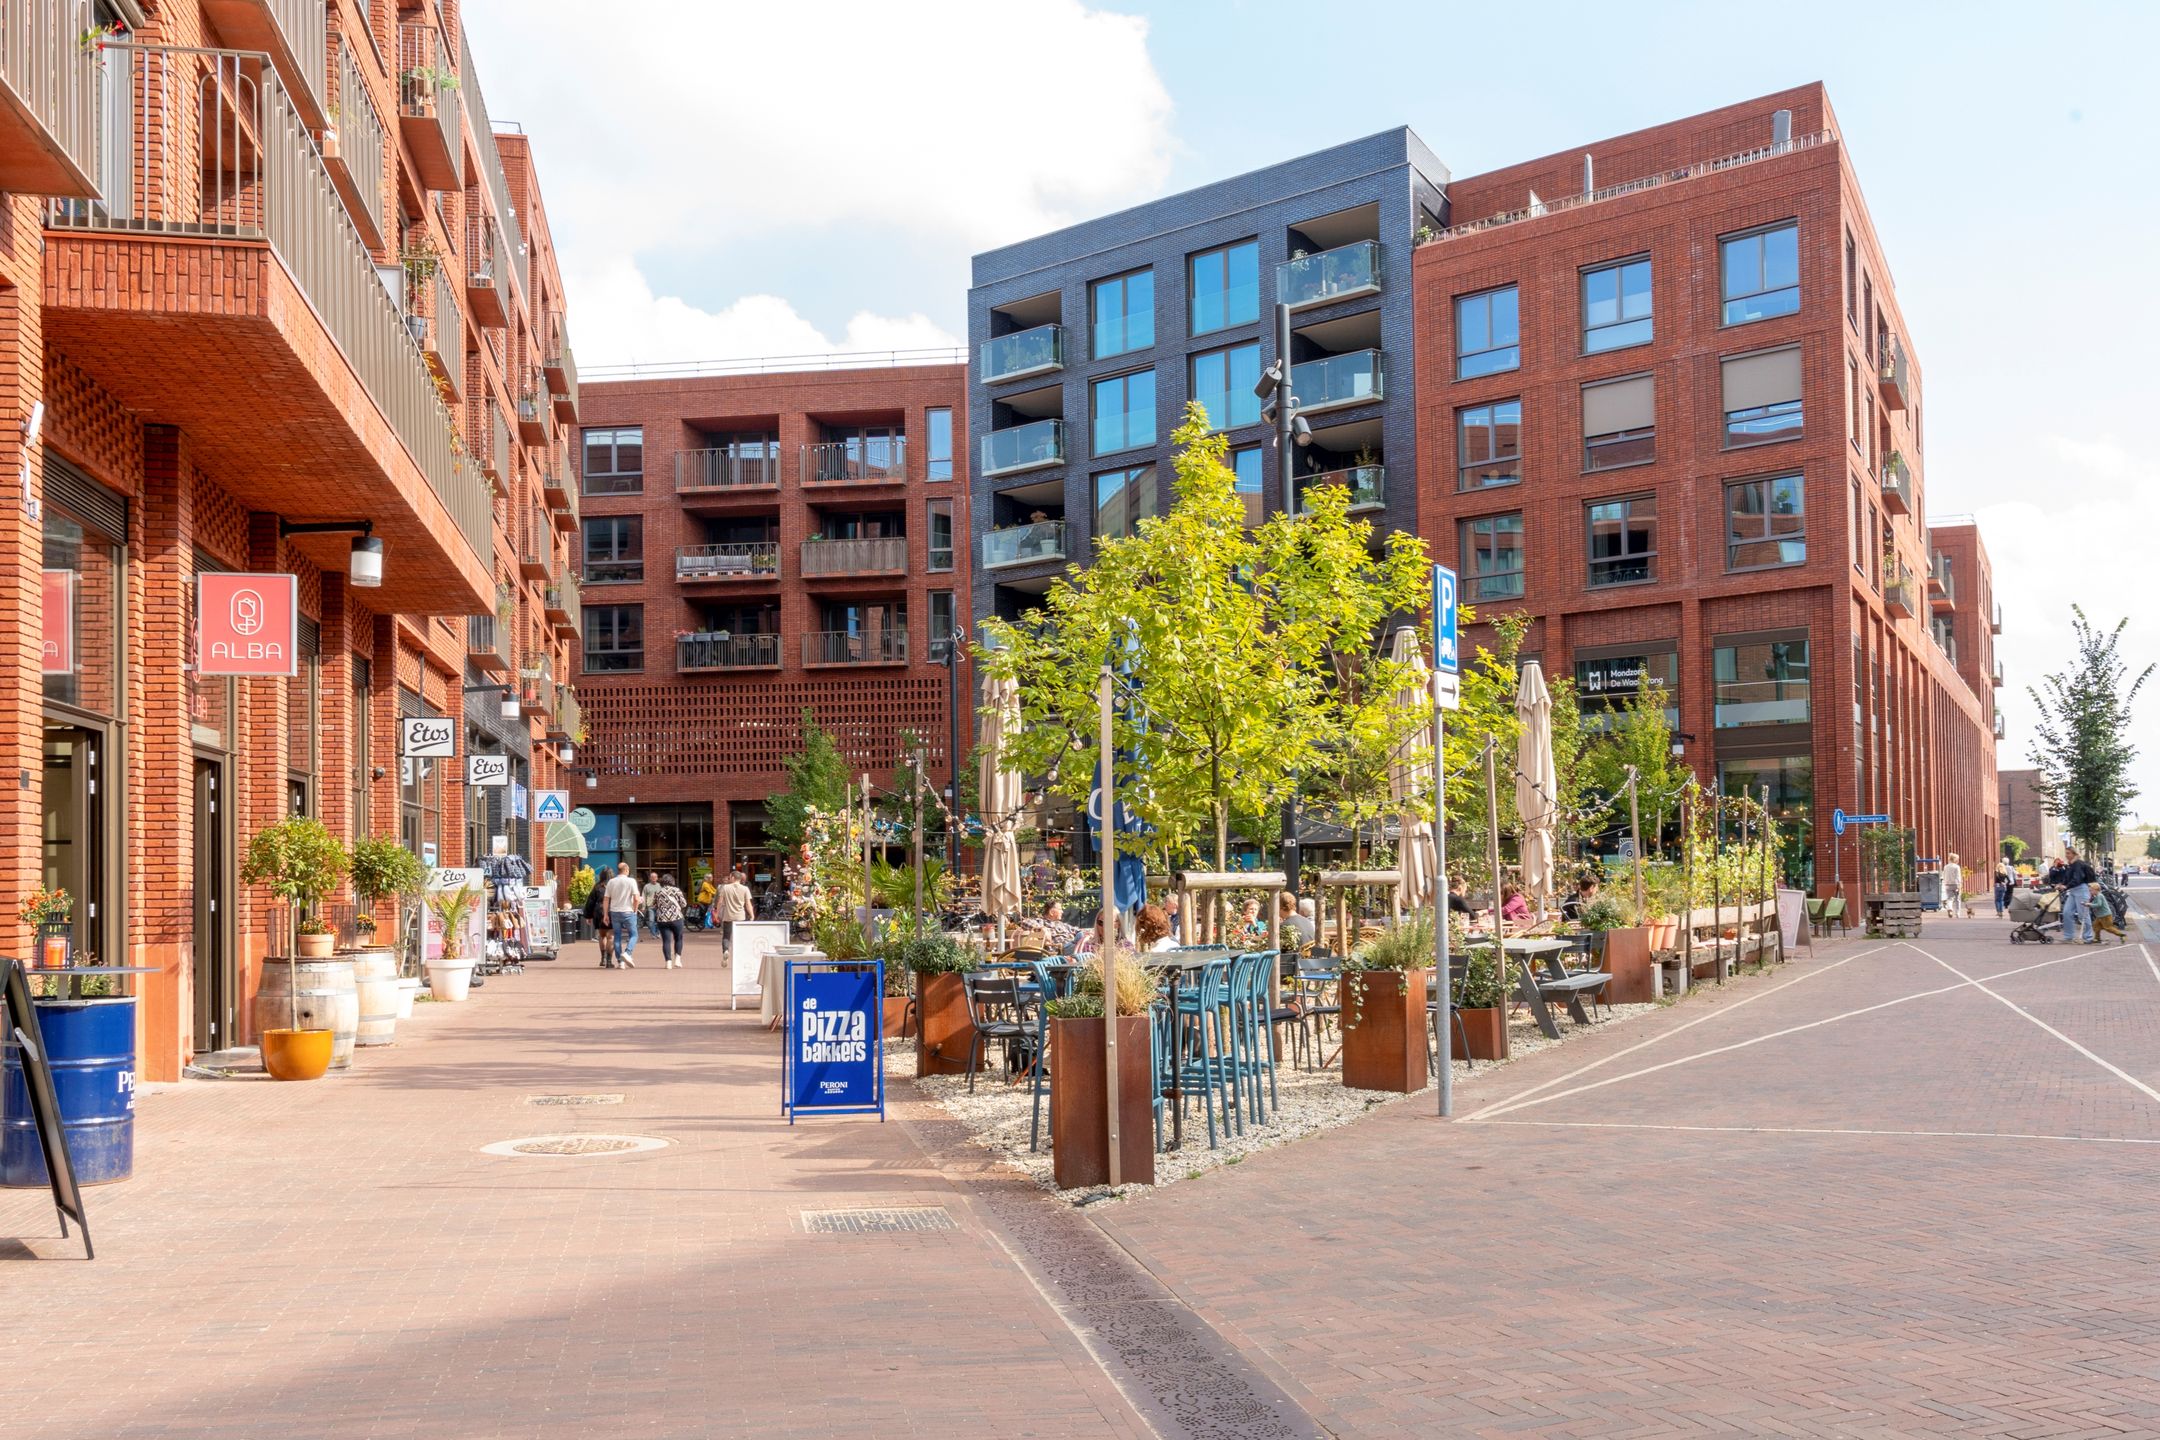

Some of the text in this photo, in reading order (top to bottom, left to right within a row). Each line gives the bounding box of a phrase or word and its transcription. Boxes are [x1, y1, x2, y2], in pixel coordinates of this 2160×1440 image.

[1441, 577, 1453, 626] P
[211, 641, 282, 660] ALBA
[191, 692, 208, 720] LBA
[409, 722, 450, 743] Etos
[473, 758, 505, 775] Etos
[443, 869, 466, 882] Etos
[803, 998, 817, 1010] de
[802, 1041, 866, 1063] bakkers
[820, 1081, 848, 1089] PERONI
